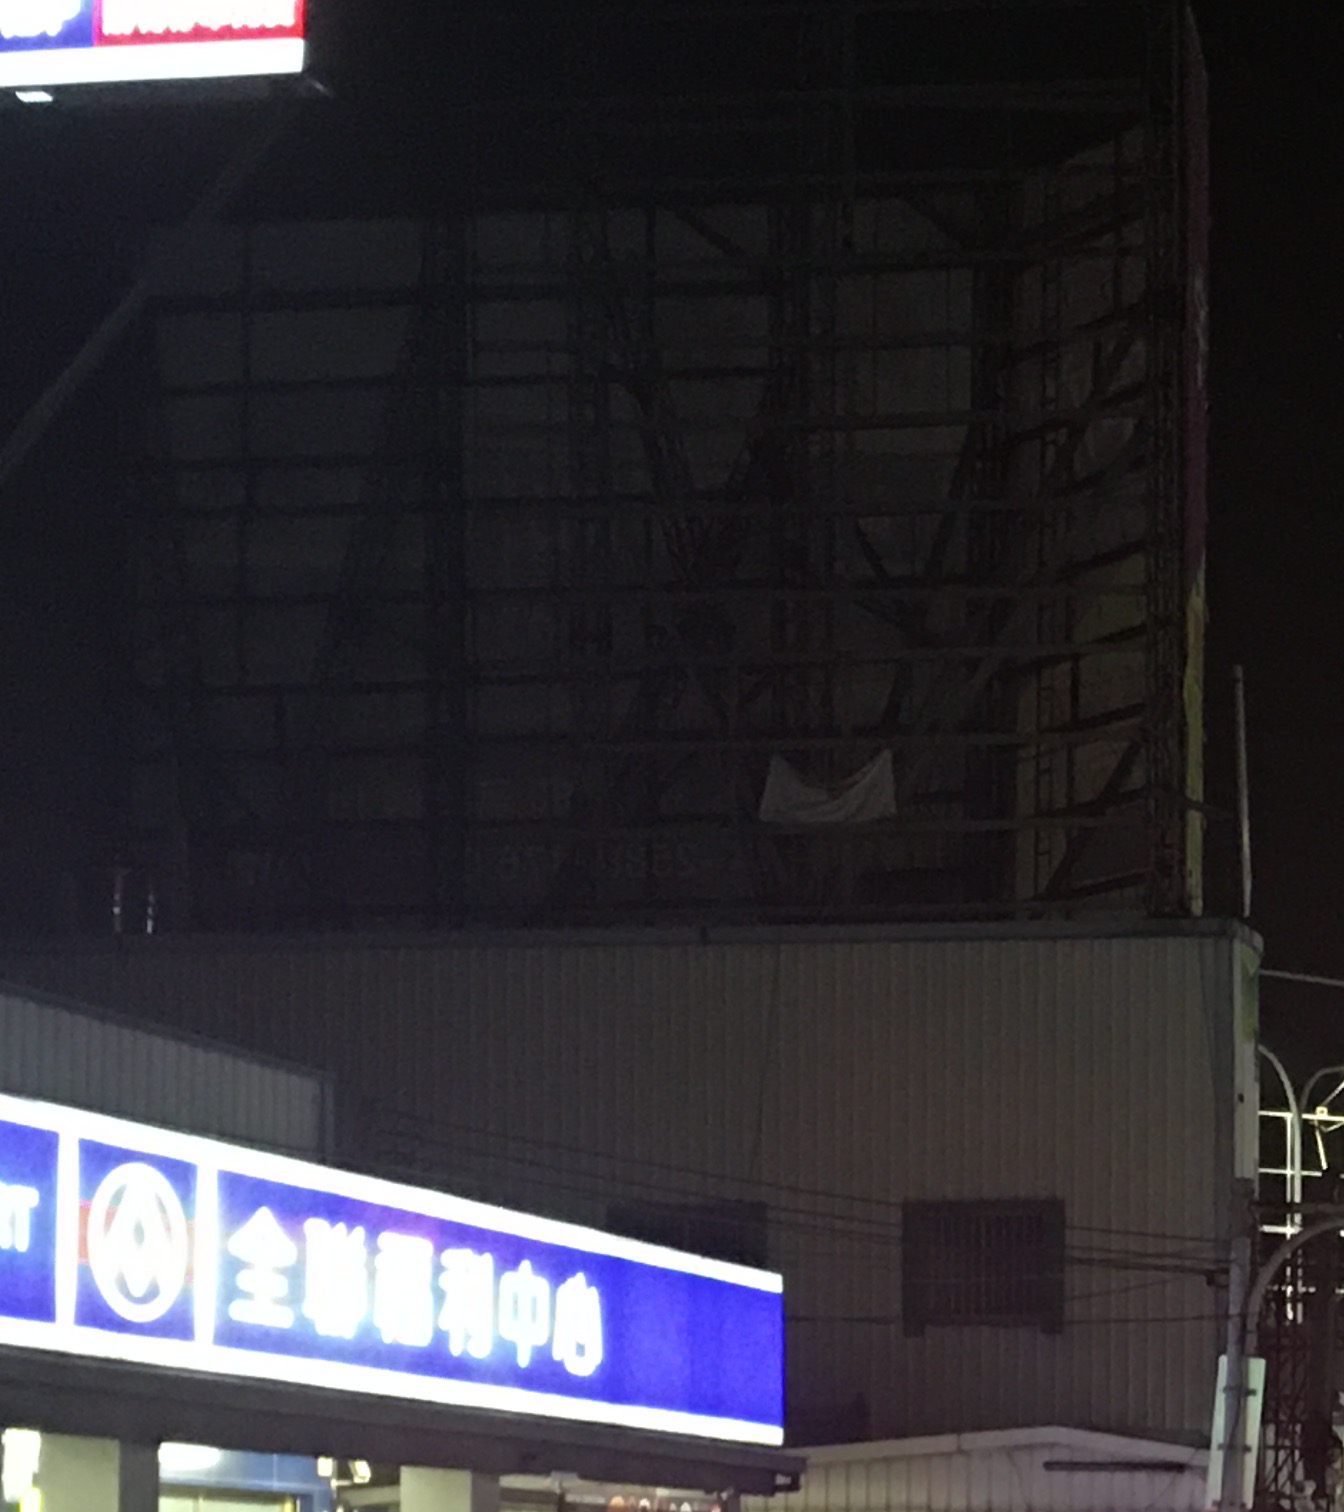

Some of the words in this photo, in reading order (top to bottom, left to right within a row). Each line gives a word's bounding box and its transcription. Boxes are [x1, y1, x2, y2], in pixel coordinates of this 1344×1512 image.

[226, 1205, 604, 1377] 全聯福利中心
